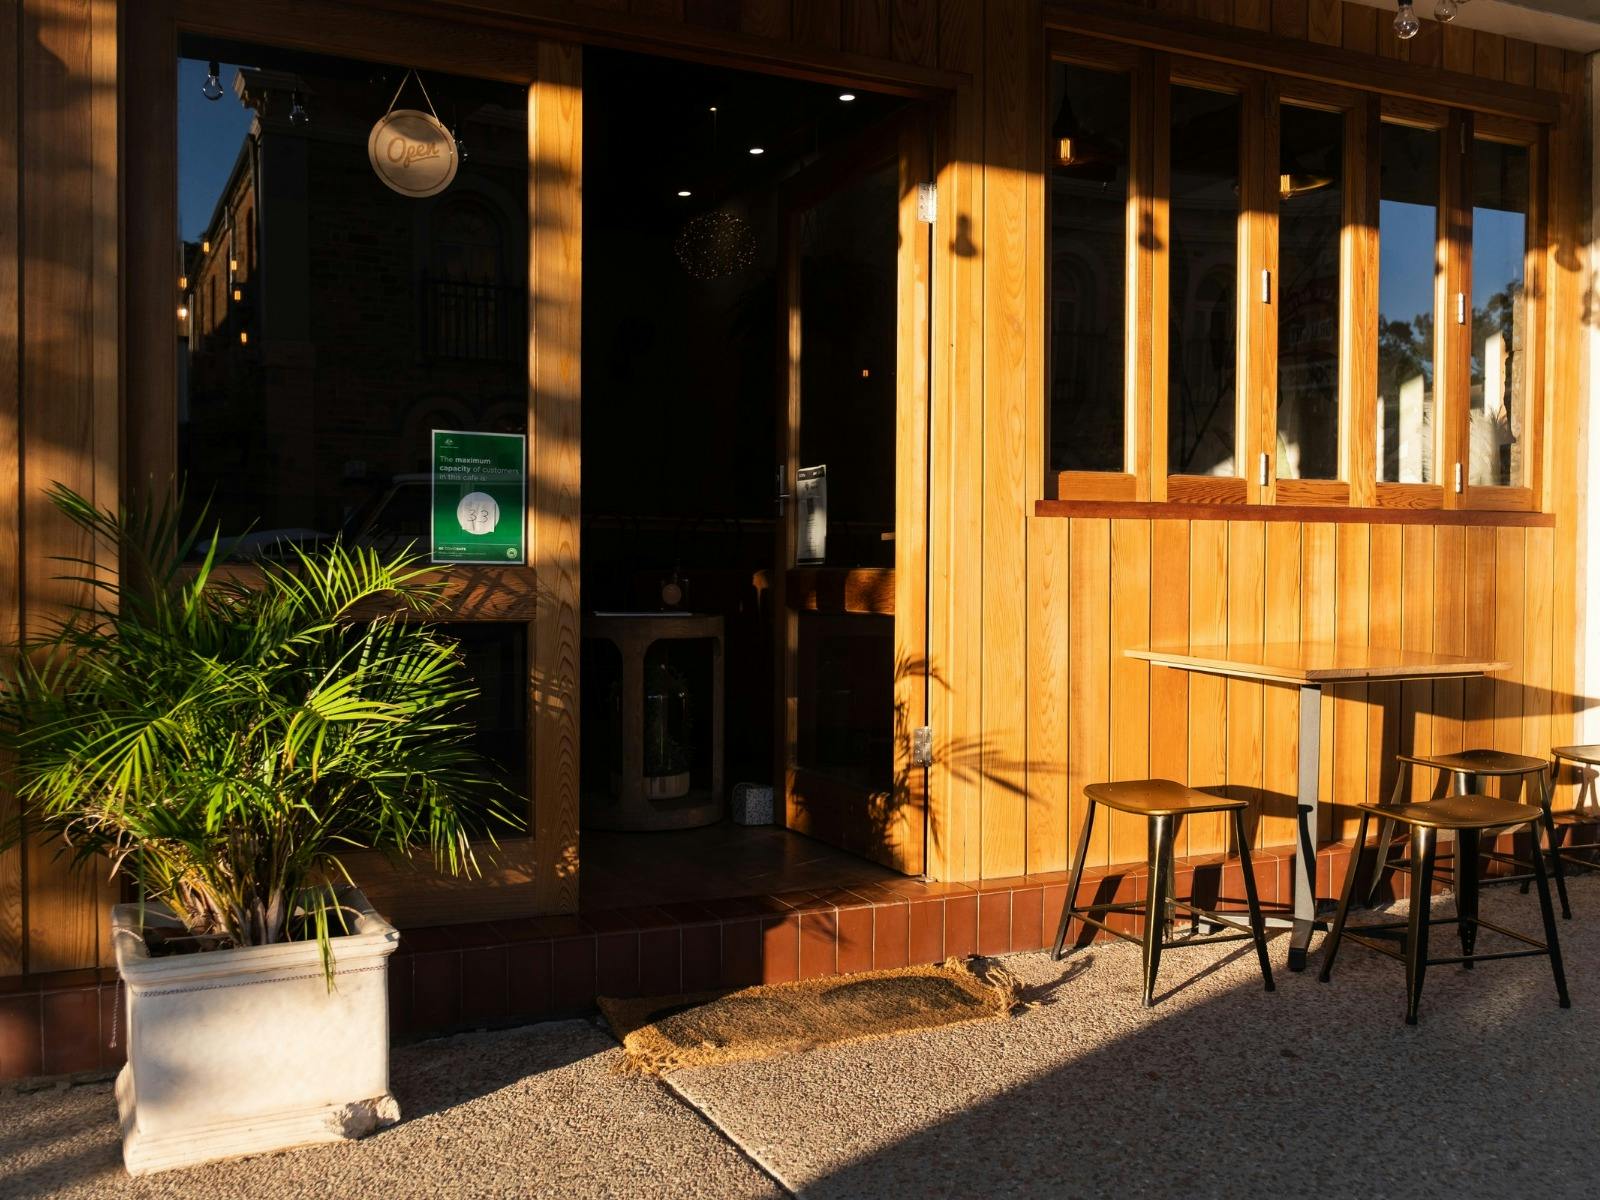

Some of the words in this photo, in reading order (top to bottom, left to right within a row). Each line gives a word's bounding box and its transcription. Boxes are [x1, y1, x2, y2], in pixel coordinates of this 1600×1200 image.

[387, 137, 440, 168] Open
[440, 455, 454, 463] The
[455, 457, 491, 465] maximum
[439, 465, 471, 473] capacity
[482, 467, 519, 475] customers
